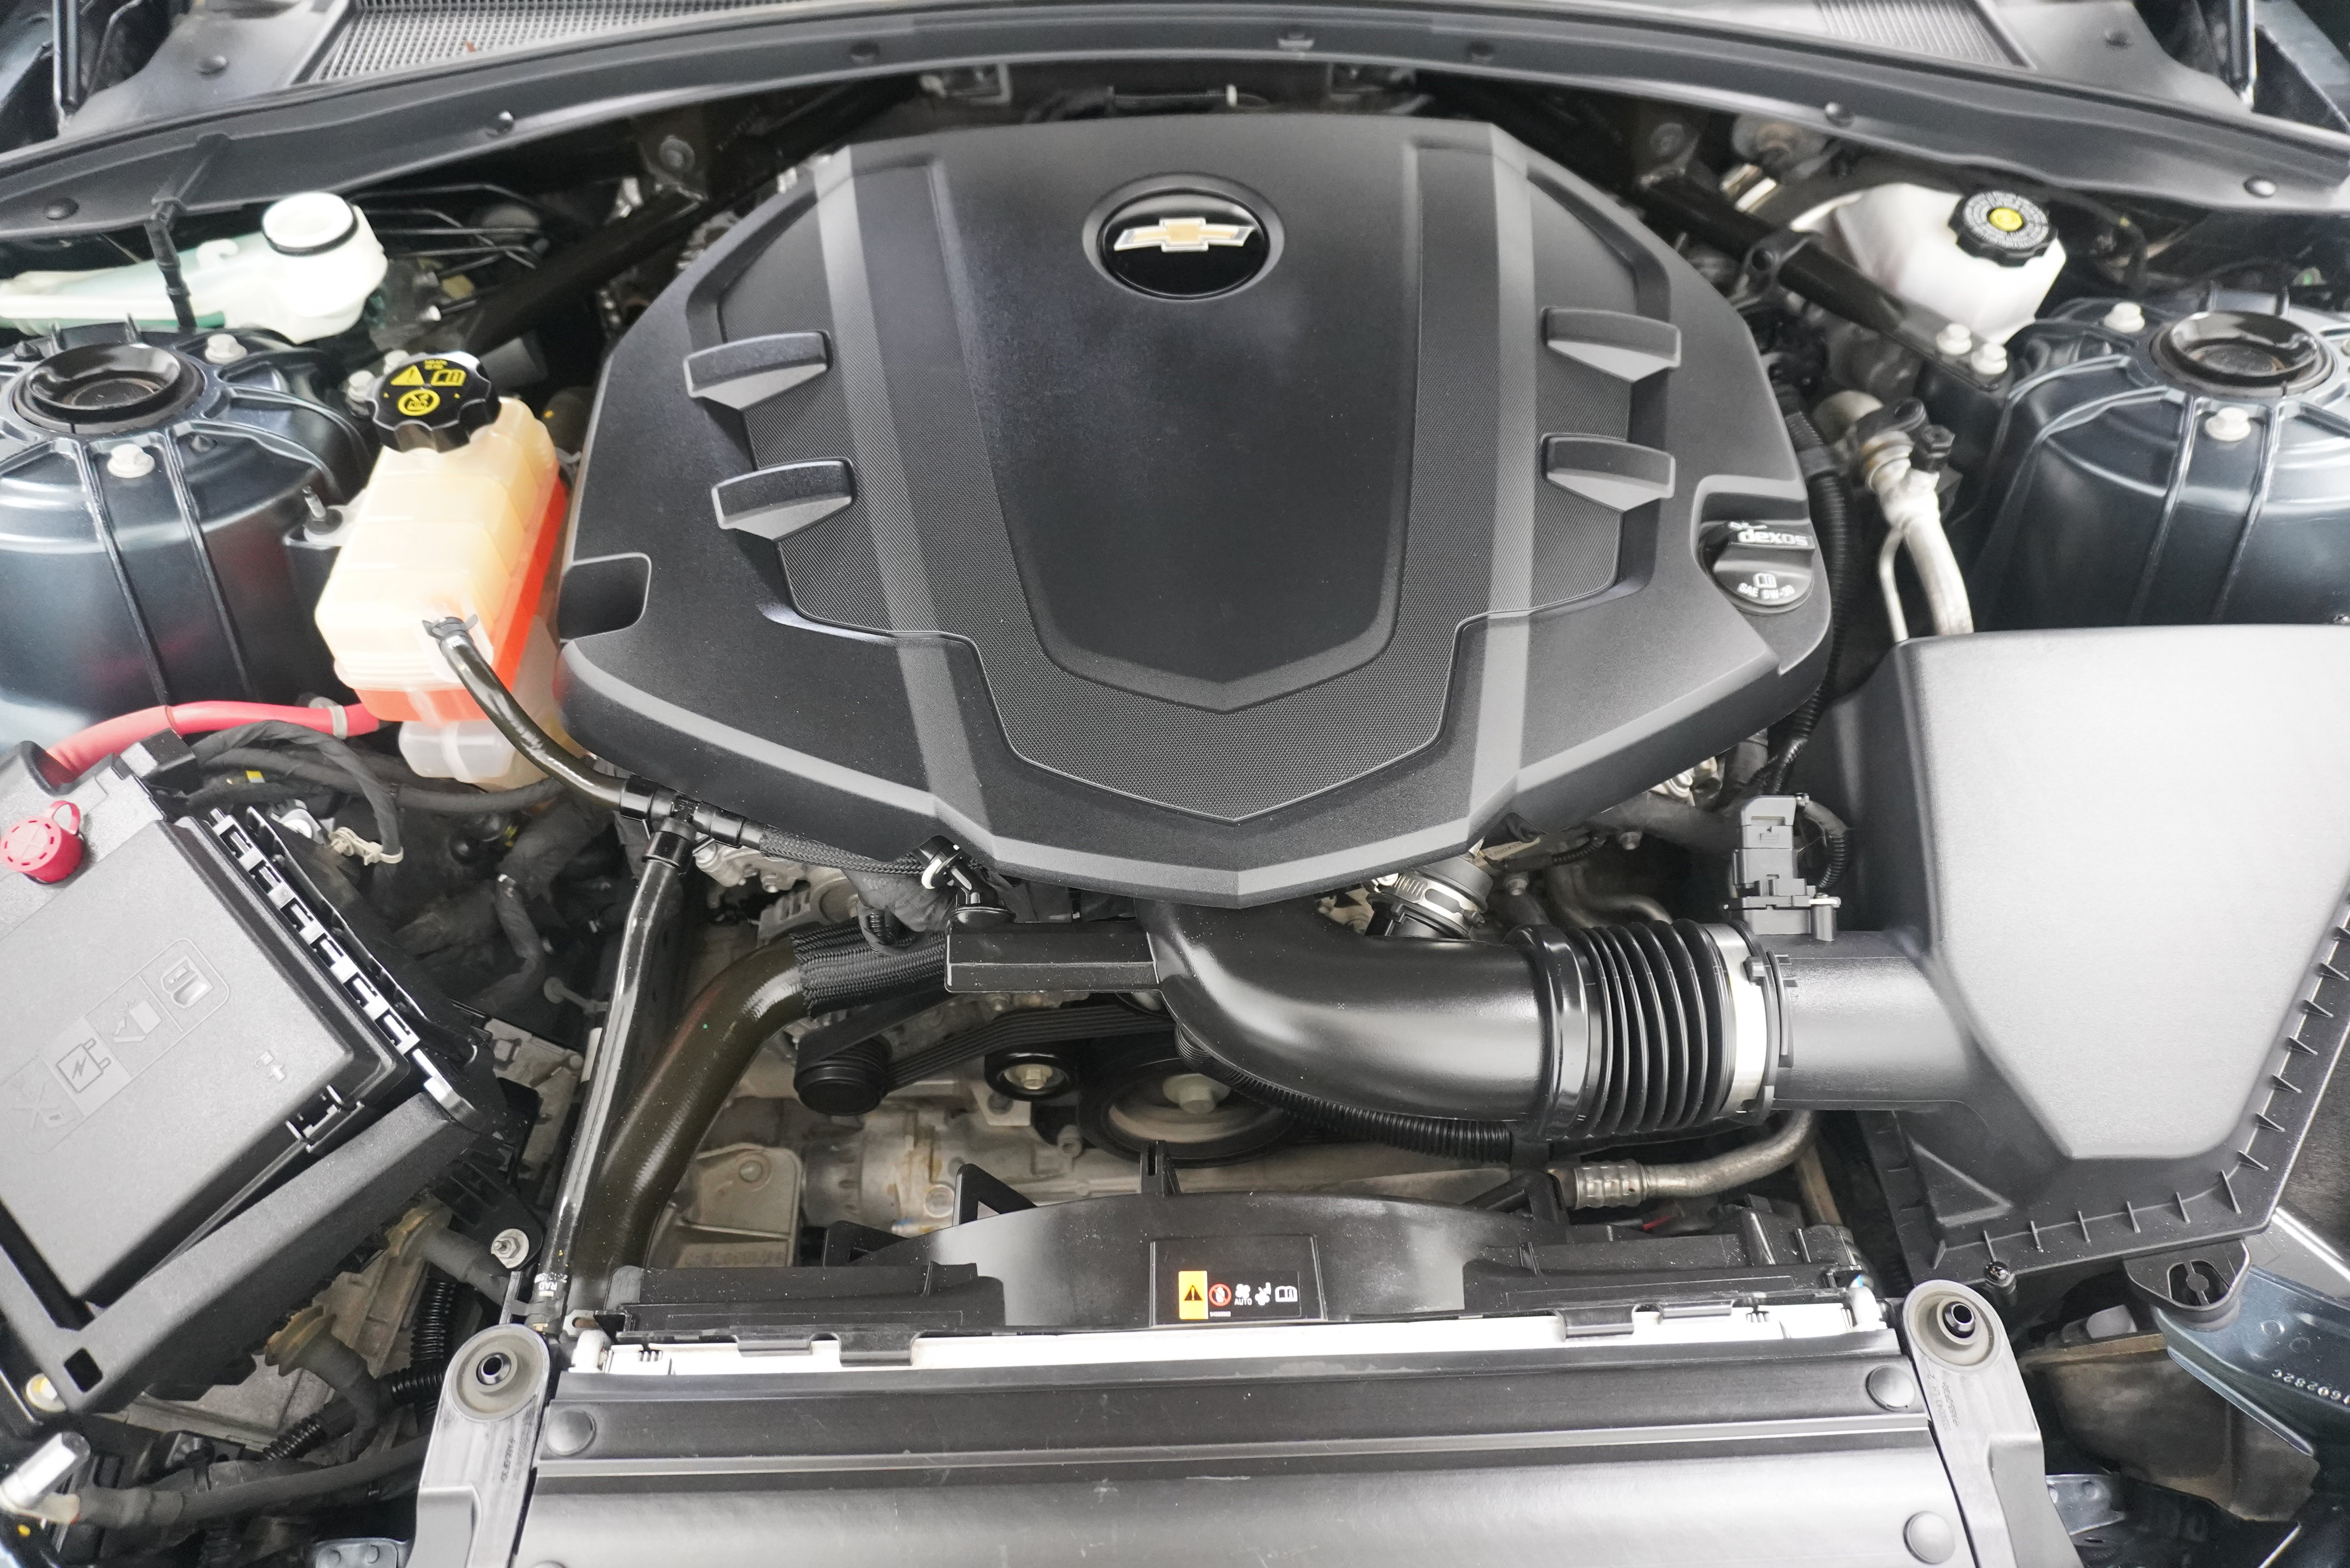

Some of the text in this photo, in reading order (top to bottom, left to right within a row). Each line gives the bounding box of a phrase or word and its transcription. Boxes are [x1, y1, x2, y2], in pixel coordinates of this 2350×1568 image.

[1737, 529, 1808, 546] dexos
[1738, 583, 1795, 599] SAE 5W-30
[539, 1281, 557, 1291] RAD
